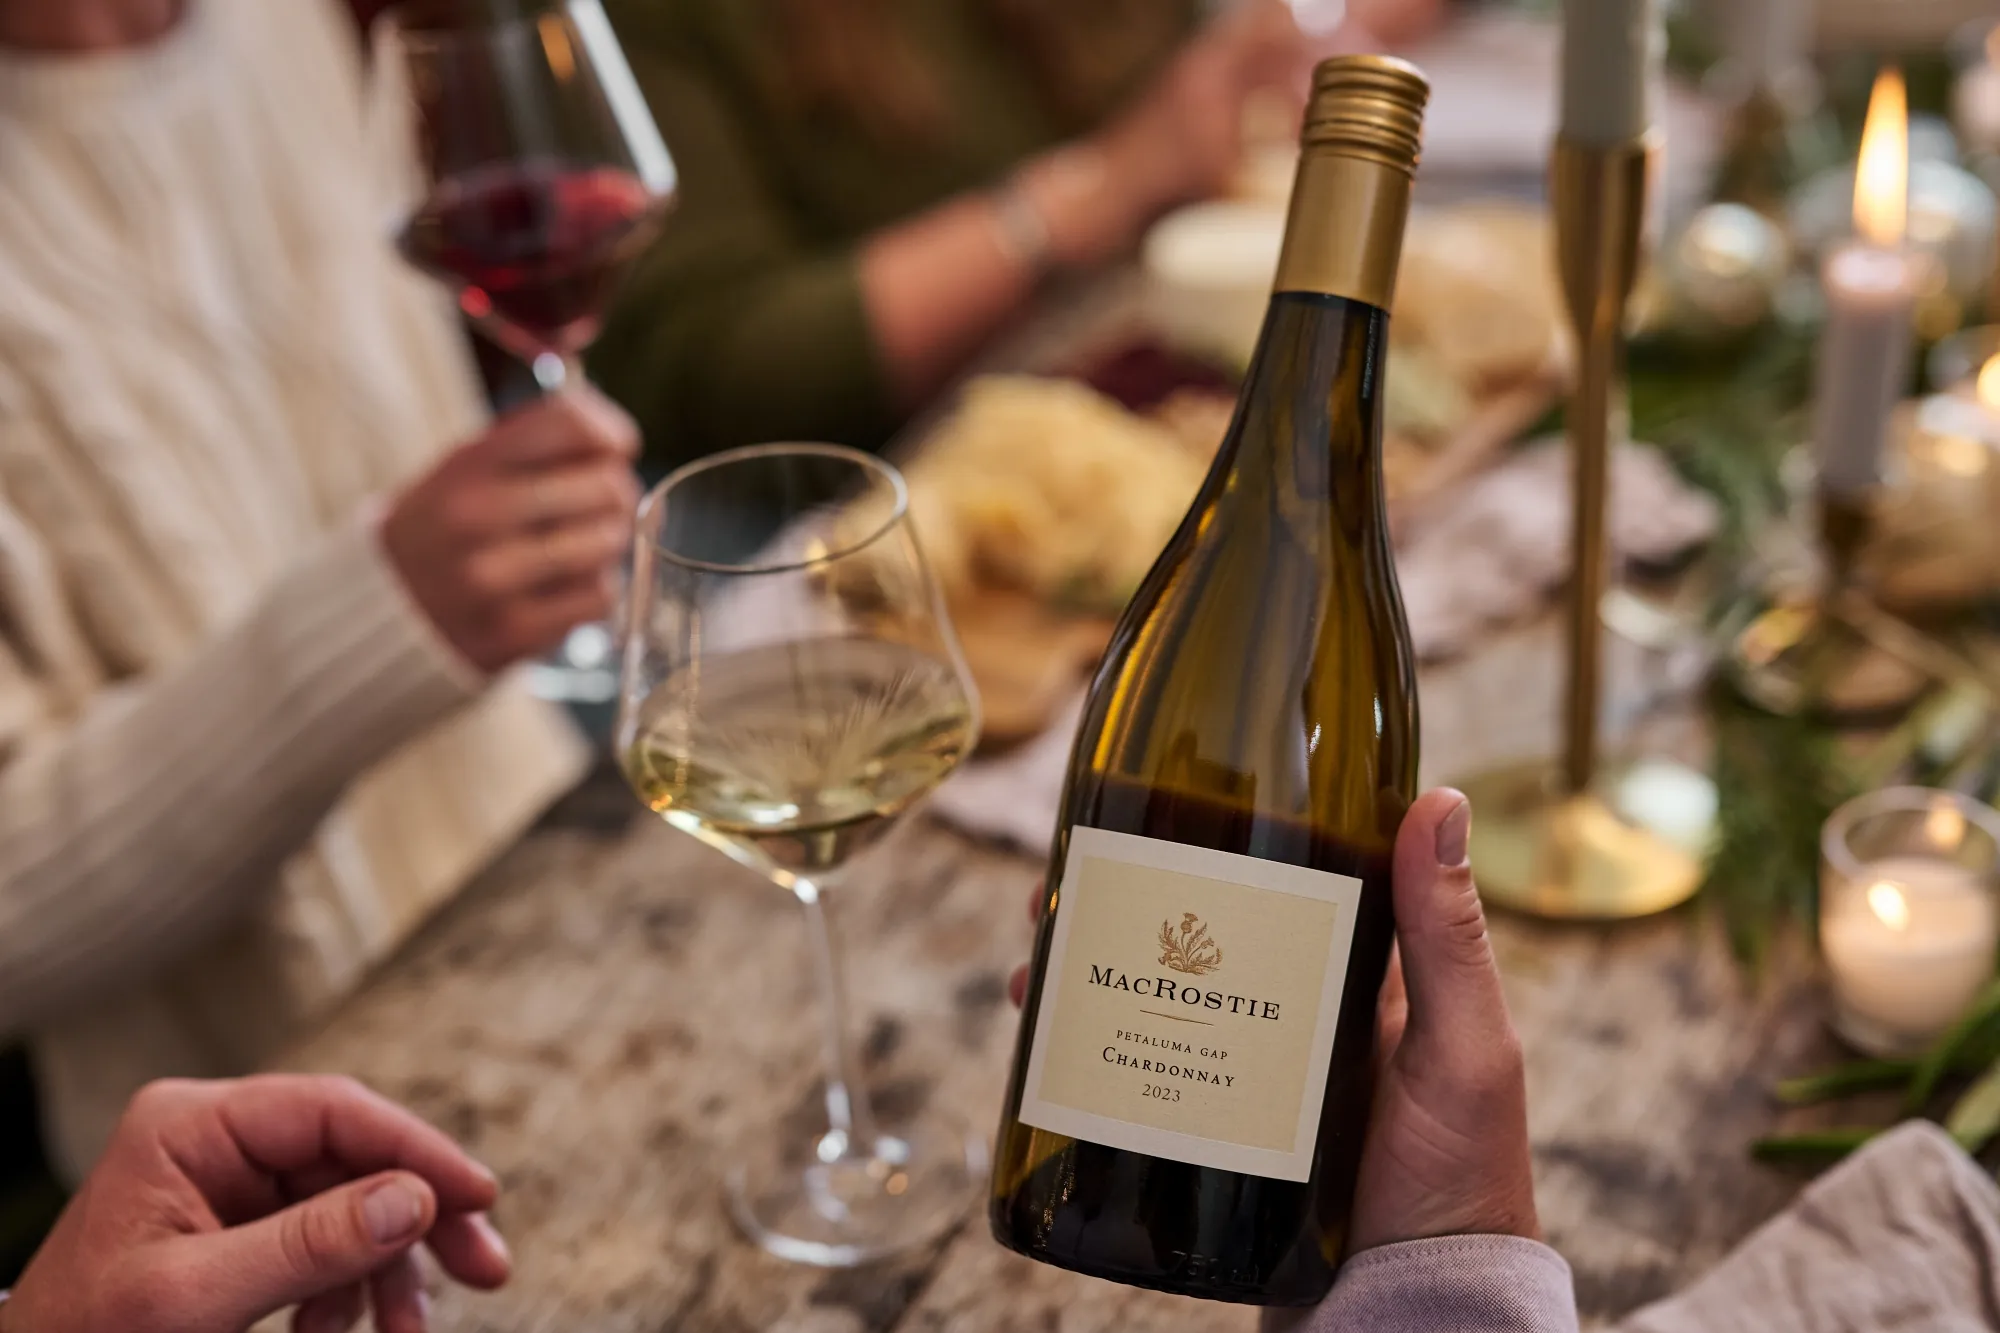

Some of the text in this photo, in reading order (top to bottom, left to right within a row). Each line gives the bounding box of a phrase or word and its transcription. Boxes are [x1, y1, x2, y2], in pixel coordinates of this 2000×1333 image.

[1116, 1029, 1229, 1061] PETALUMA GAP
[1142, 1083, 1182, 1103] 2023
